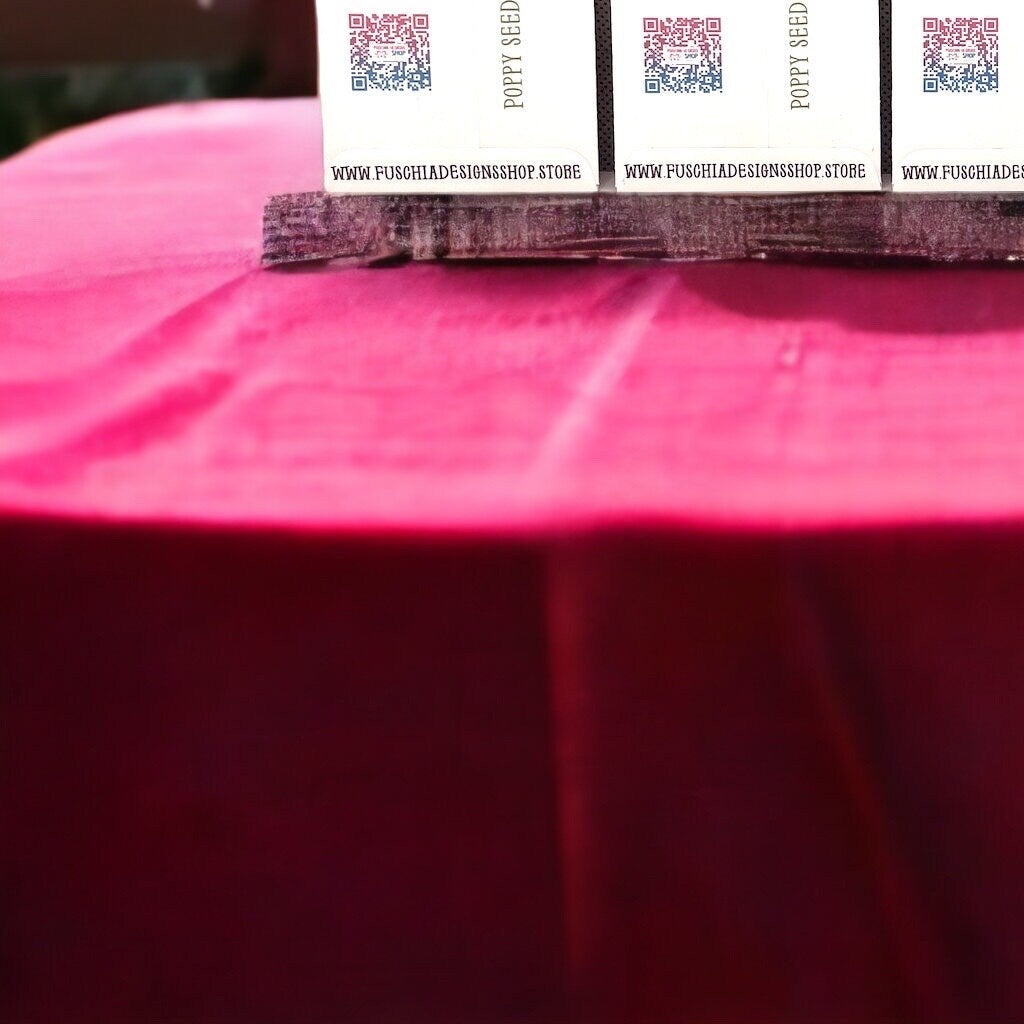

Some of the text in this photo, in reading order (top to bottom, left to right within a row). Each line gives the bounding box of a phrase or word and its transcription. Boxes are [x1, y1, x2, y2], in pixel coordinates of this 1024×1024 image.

[501, 52, 524, 110] POPPY
[788, 54, 810, 111] POPPY
[329, 163, 582, 181] WWW.FUSCHIADESIGNSSHOP.STORE
[623, 162, 866, 179] WWW.FUSCHIADESIGNSSHOP.STORE
